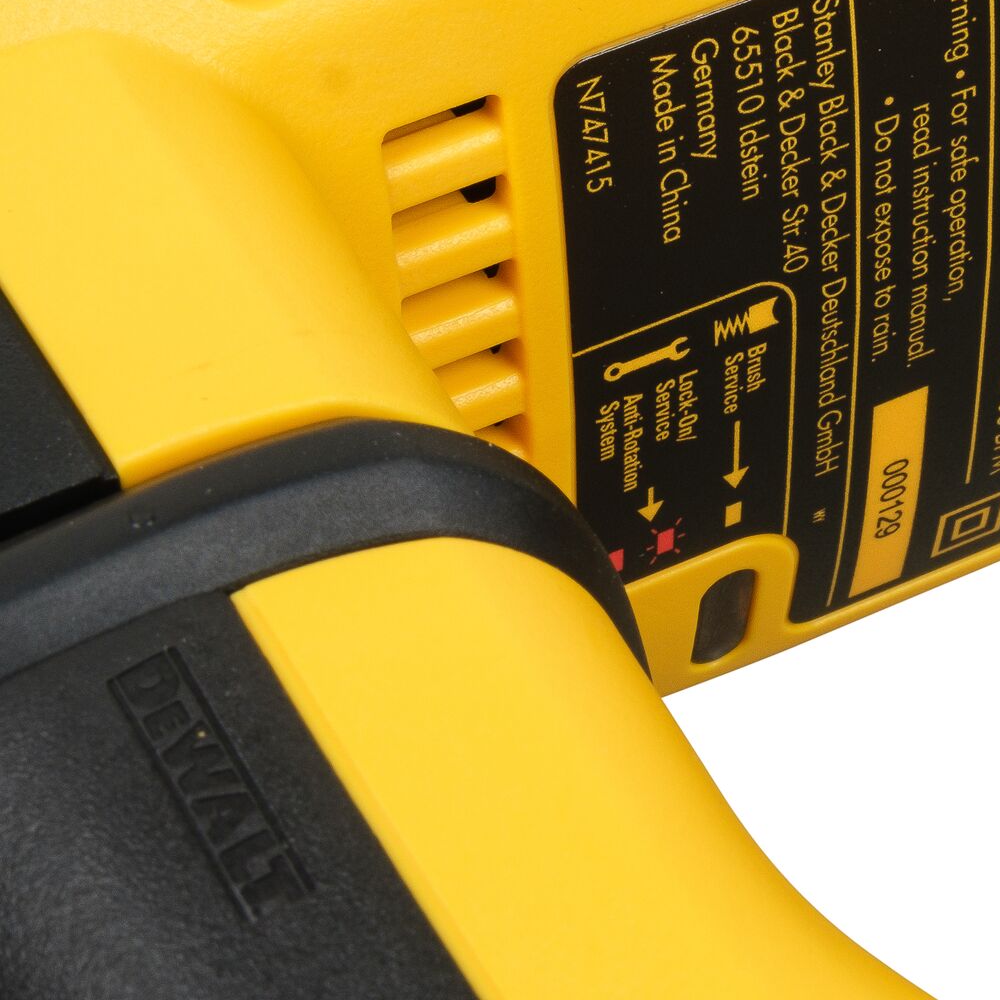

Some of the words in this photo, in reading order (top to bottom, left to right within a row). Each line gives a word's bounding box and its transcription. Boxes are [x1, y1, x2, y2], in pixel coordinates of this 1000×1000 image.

[732, 26, 764, 114] 65510
[772, 8, 806, 82] Black
[650, 54, 686, 132] Made
[691, 38, 719, 158] Germany
[778, 88, 804, 110] &
[819, 95, 849, 164] Black
[951, 86, 976, 125] For
[577, 76, 612, 193] N747415
[658, 136, 684, 164] in
[739, 119, 769, 200] Idstein
[780, 113, 810, 197] Decker
[875, 114, 900, 152] Do
[913, 103, 941, 159] read
[951, 136, 979, 182] safe
[660, 169, 691, 243] China
[821, 169, 846, 191] &
[875, 159, 896, 195] not
[821, 192, 849, 272] Decker
[867, 203, 891, 281] expose
[912, 165, 936, 279] instruction
[942, 189, 974, 302] operation,
[874, 285, 896, 308] to
[905, 283, 934, 368] manual.
[747, 343, 767, 392] Brush
[819, 277, 848, 407] Deutschland
[871, 313, 897, 363] rain.
[656, 379, 675, 441] Service
[677, 369, 698, 441] Lock-On/
[724, 352, 744, 414] Service
[596, 401, 620, 460] System
[624, 394, 643, 492] Anti-Rotation
[816, 410, 843, 476] GmbH
[873, 458, 909, 540] 000129
[118, 652, 302, 914] DEWALT
